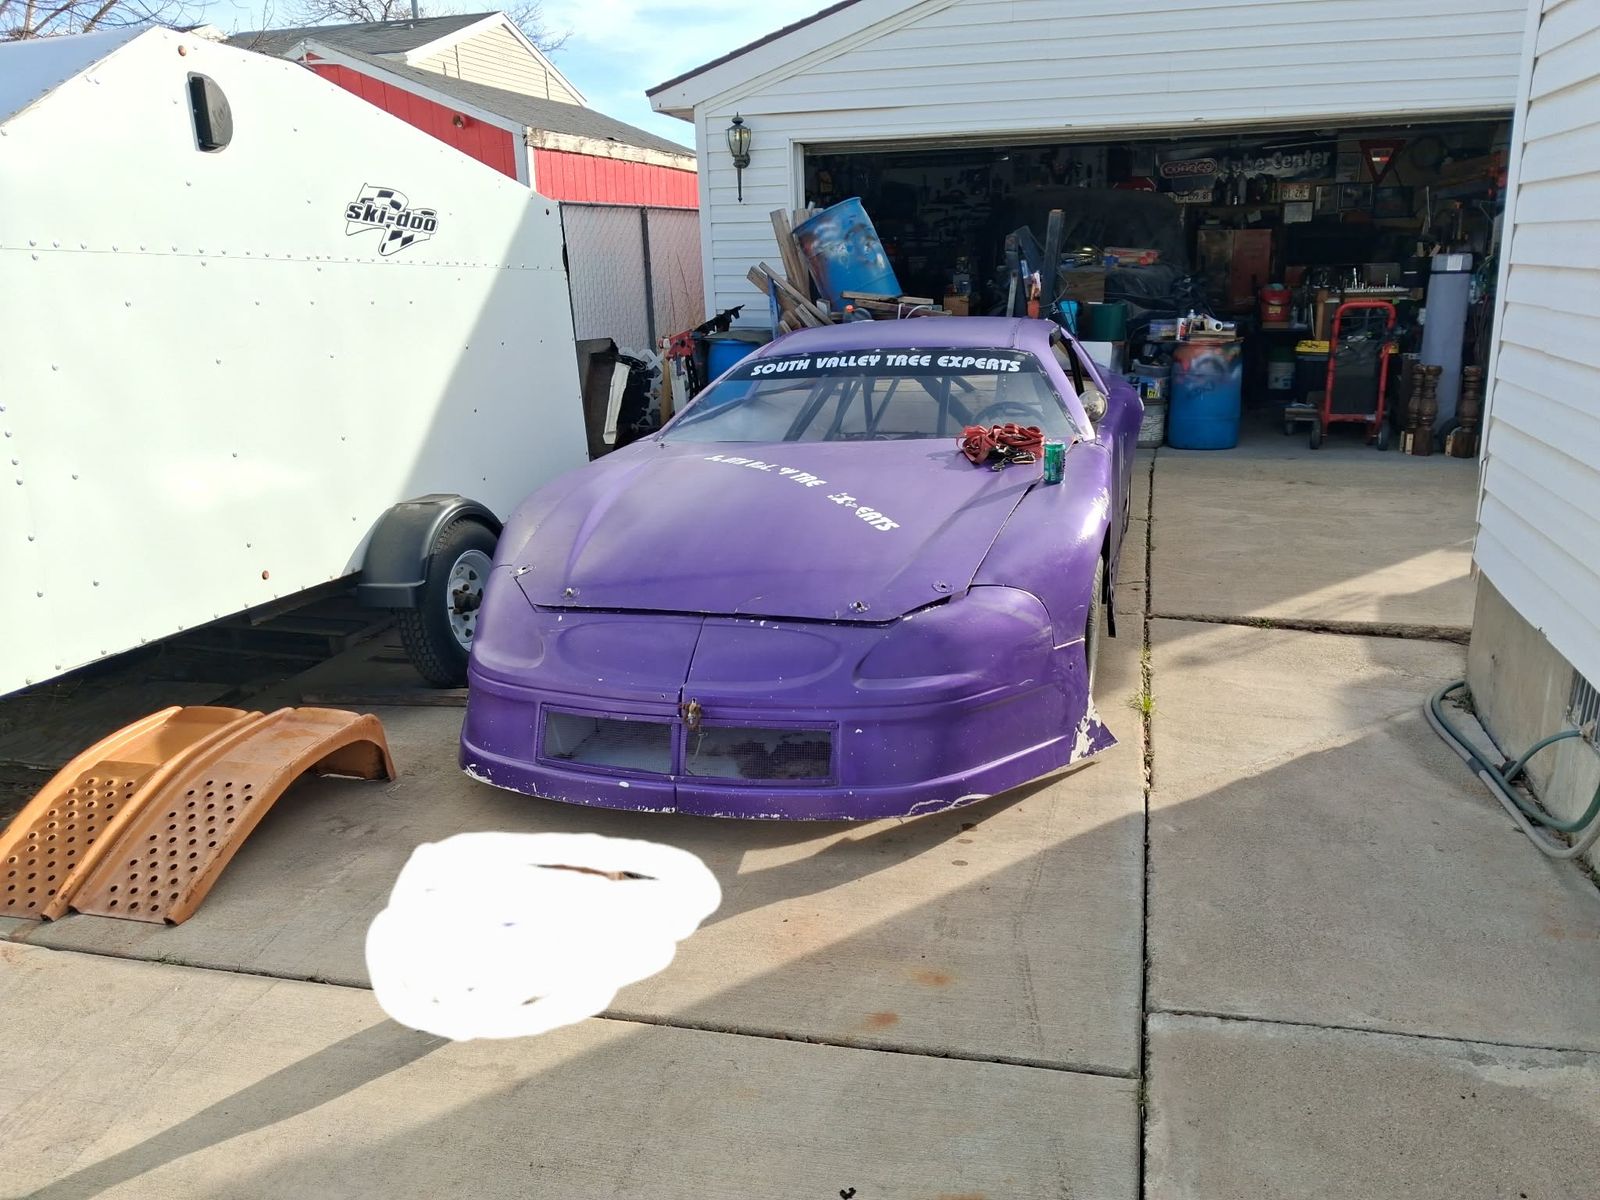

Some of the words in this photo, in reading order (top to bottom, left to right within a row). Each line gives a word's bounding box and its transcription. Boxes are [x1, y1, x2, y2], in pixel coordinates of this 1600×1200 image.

[750, 359, 811, 376] SOUTH
[816, 355, 880, 368] VALLEY
[886, 355, 932, 366] TREE
[937, 355, 1021, 372] EXPERTS
